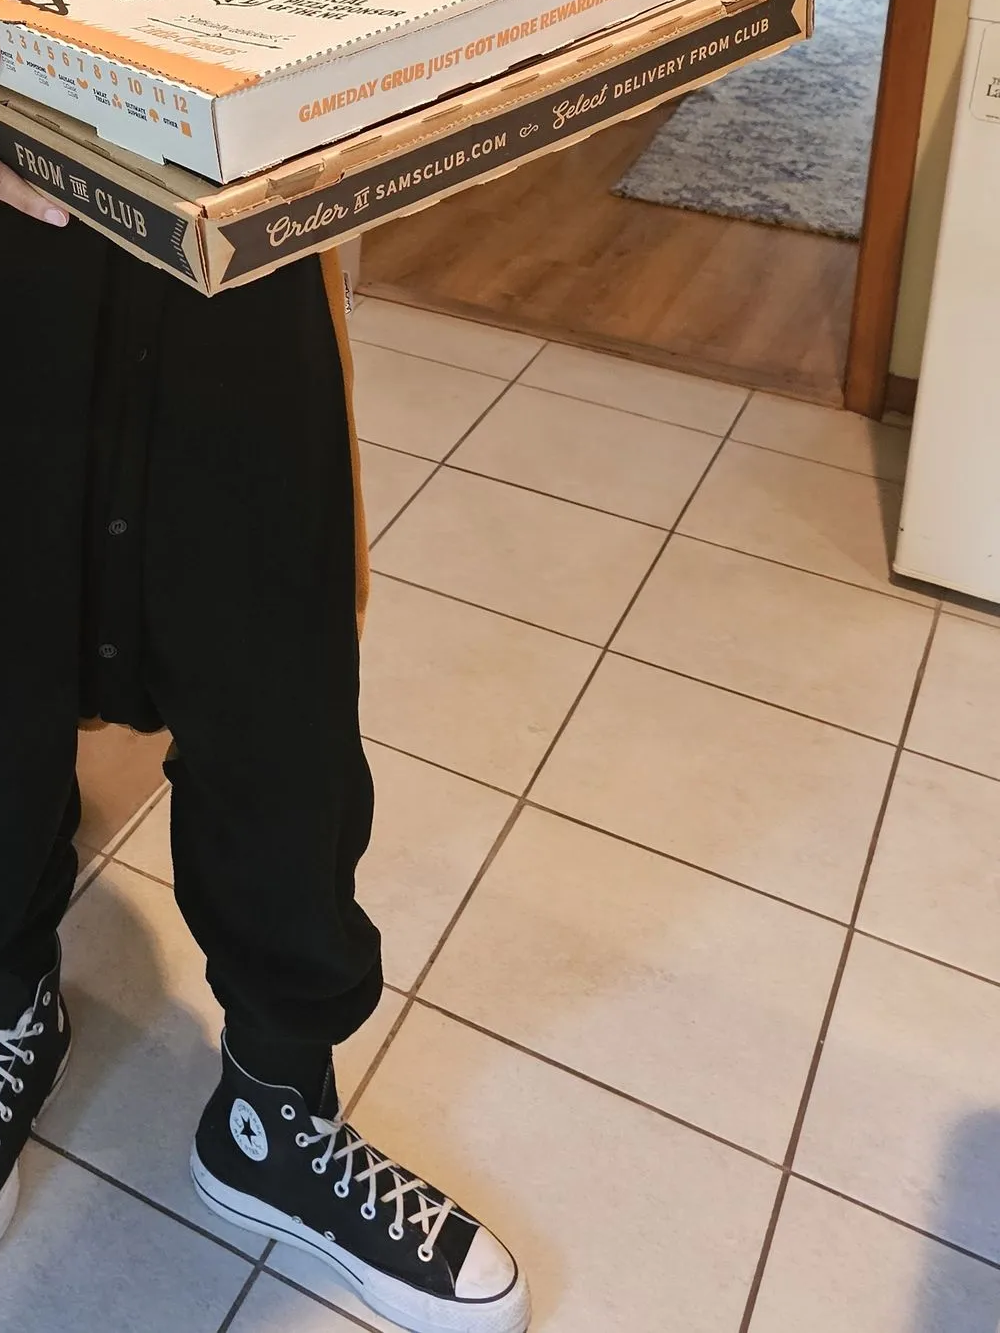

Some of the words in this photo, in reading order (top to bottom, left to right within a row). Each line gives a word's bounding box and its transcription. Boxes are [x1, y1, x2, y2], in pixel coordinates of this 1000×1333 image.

[267, 4, 291, 12] OF
[293, 8, 320, 18] THE
[321, 11, 349, 20] NFL
[283, 0, 328, 10] PIZZA
[328, 4, 406, 17] SPONSOR
[6, 29, 14, 44] 2
[19, 34, 27, 49] 3
[33, 41, 41, 55] 4
[47, 46, 55, 60] 5
[62, 51, 70, 67] 6
[76, 57, 84, 73] 7
[93, 64, 102, 80] 8
[110, 70, 118, 86] 9
[127, 77, 143, 96] 10
[153, 86, 165, 105] 11
[173, 94, 188, 114] 12
[299, 77, 379, 123] GAMEDAY
[381, 64, 425, 92] GRUB
[426, 46, 465, 79] JUST
[465, 34, 496, 60] GOT
[497, 20, 538, 48] MORE
[125, 102, 146, 115] ULTIMATE
[127, 109, 148, 122] SUPREME
[163, 117, 179, 129] OTHER
[266, 202, 349, 248] Order
[354, 190, 370, 212] AT
[375, 132, 508, 200] SAMSCLUB.COM
[552, 83, 609, 130] Select
[614, 55, 686, 99] DELIVERY
[690, 35, 730, 64] FROM
[735, 18, 770, 45] CLUB
[14, 142, 66, 190] FROM
[70, 178, 90, 199] THE
[95, 188, 148, 238] CLUB
